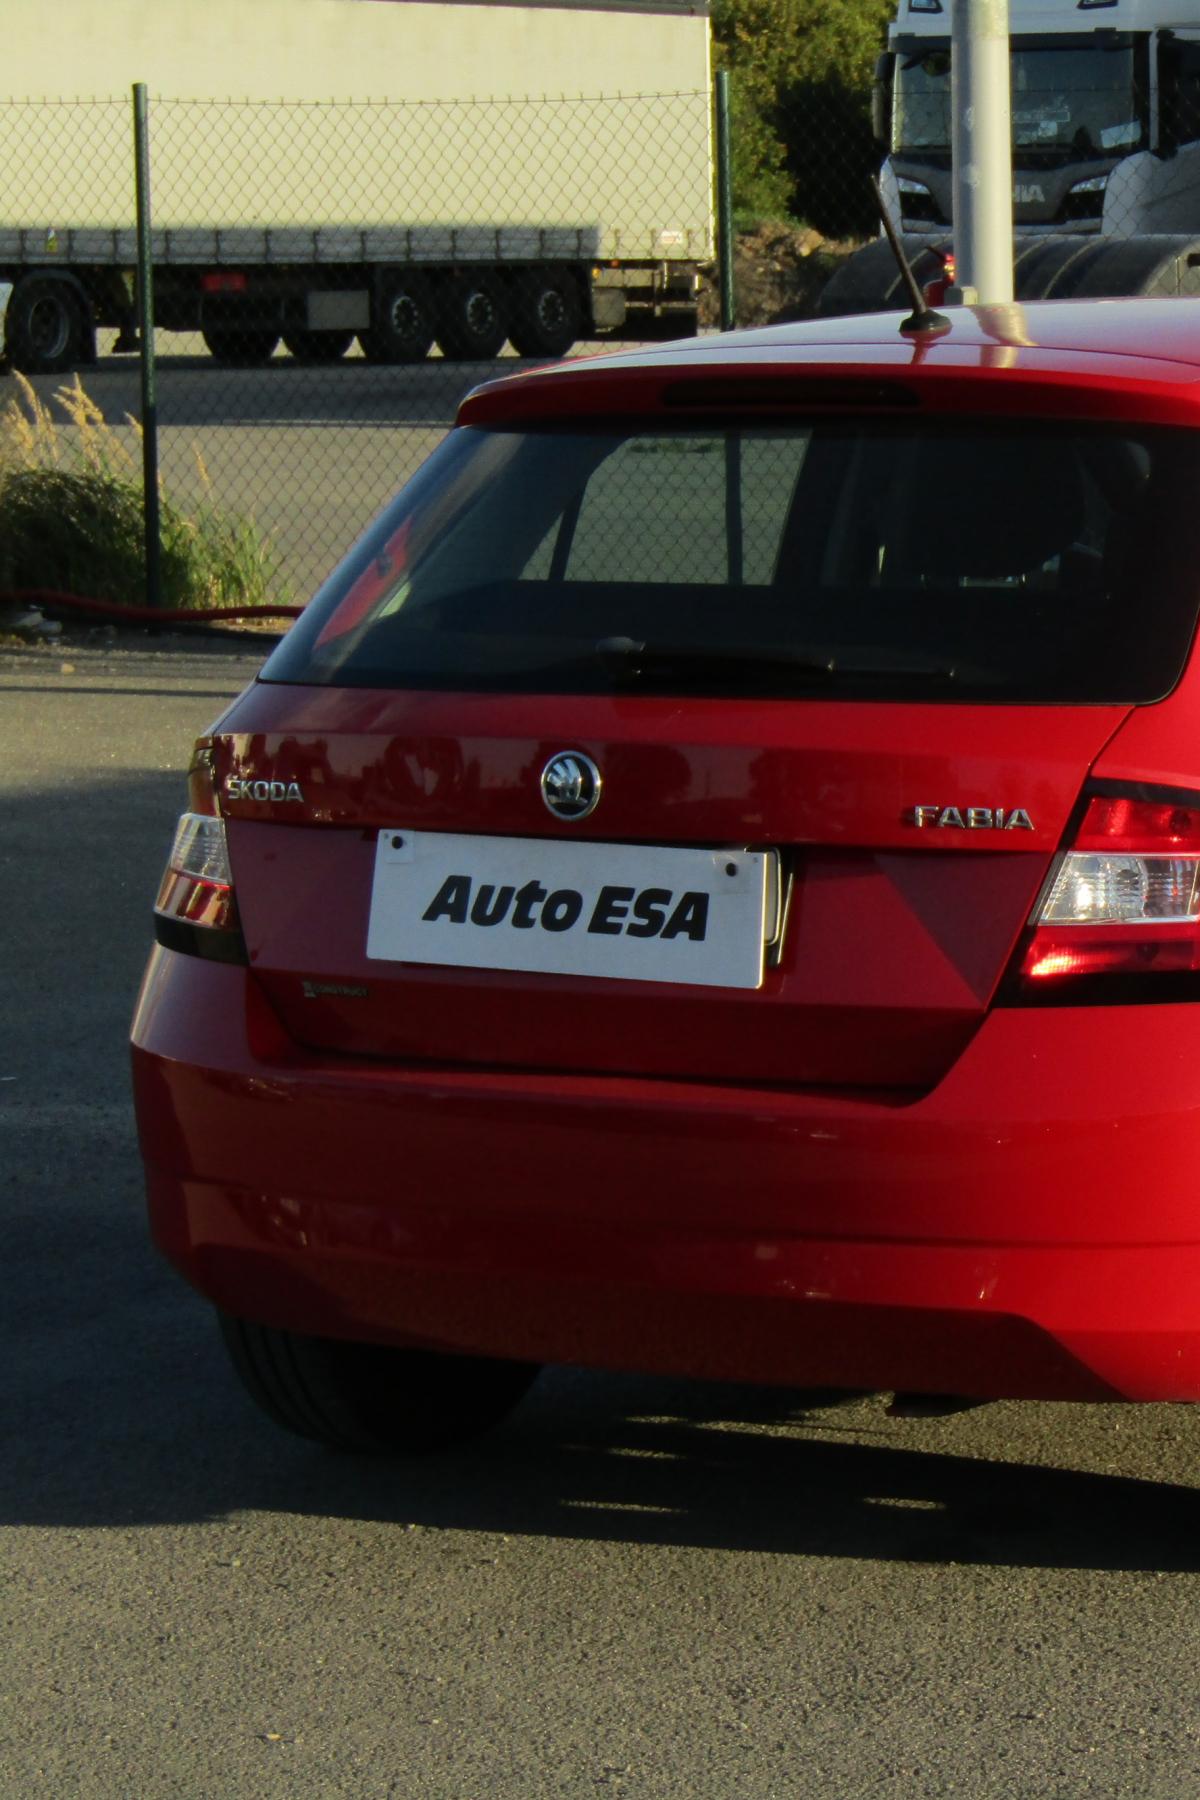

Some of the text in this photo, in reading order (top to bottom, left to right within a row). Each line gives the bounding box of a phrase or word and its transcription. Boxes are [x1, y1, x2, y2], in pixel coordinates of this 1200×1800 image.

[914, 805, 1035, 831] FABIA
[421, 875, 710, 941] Auto ESA
